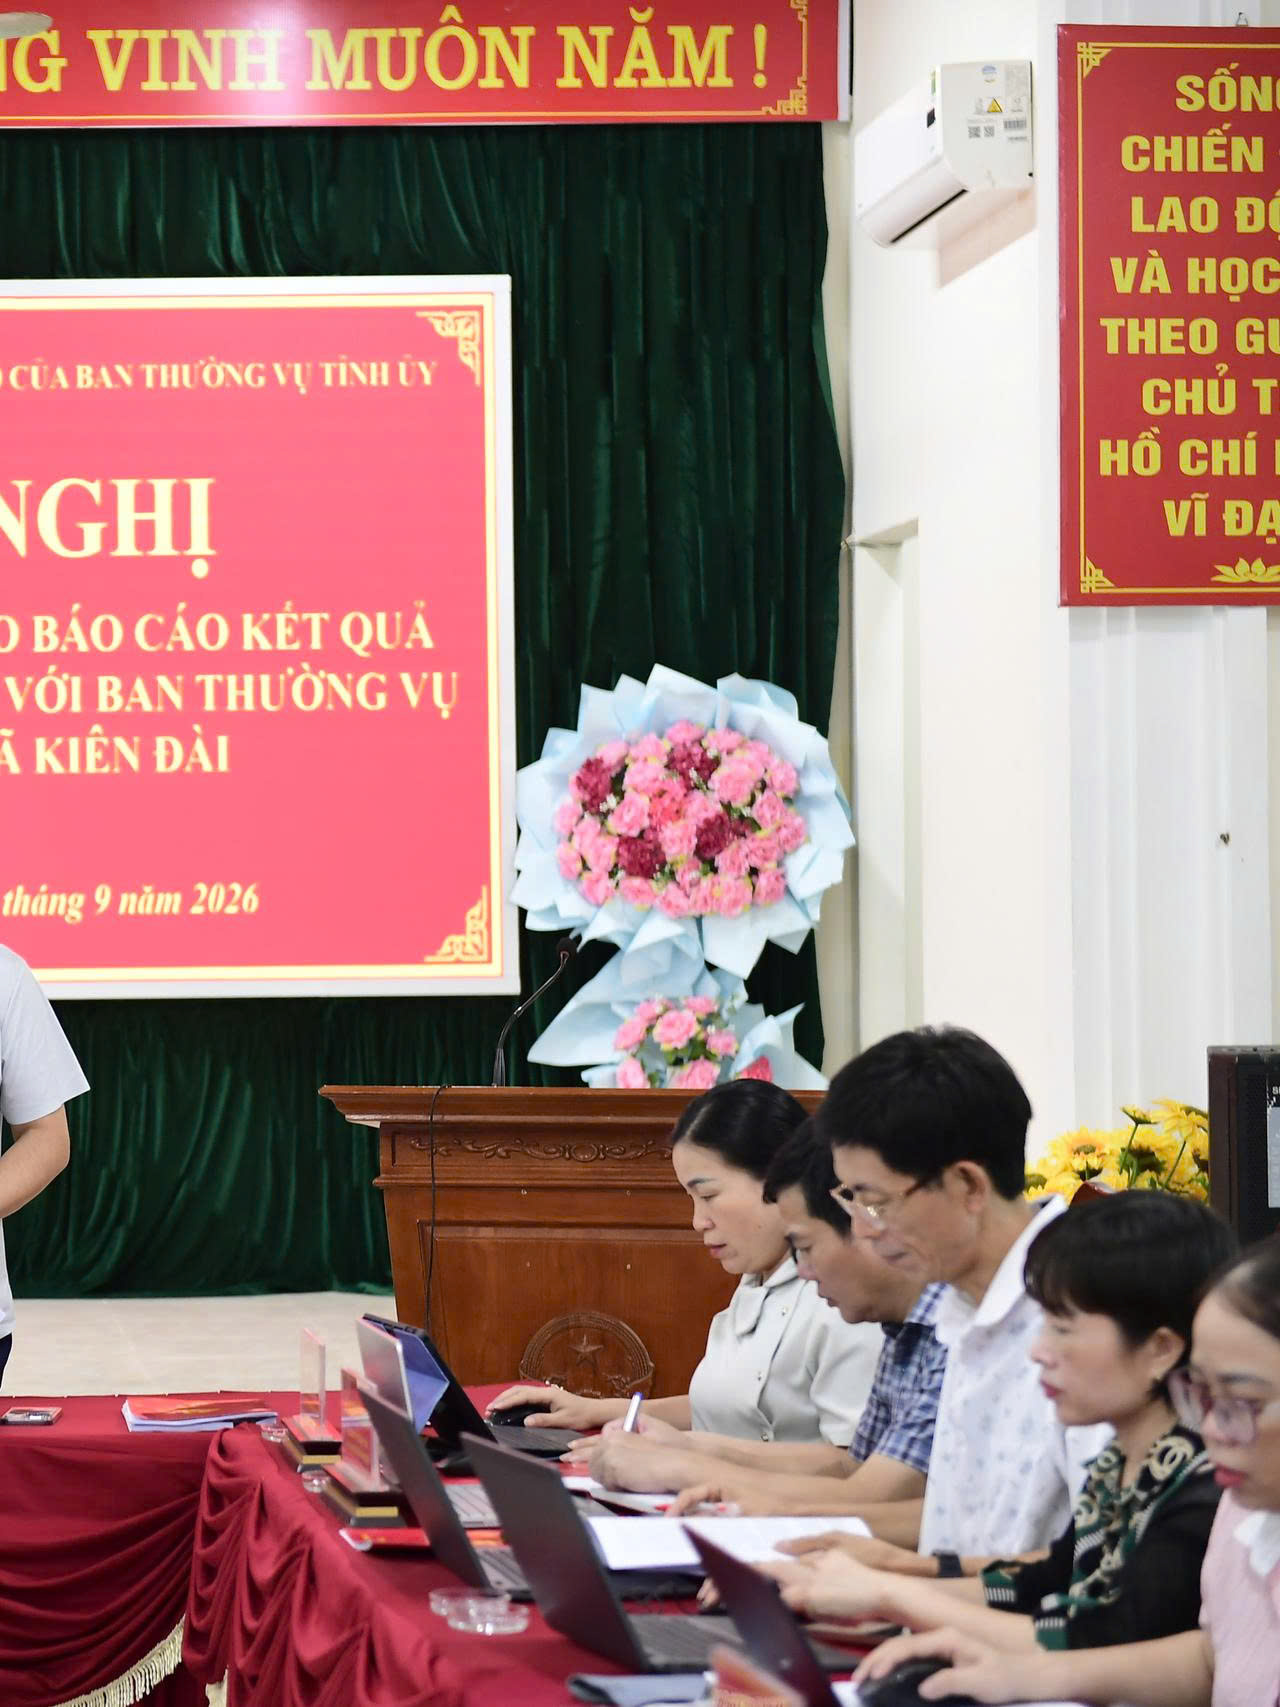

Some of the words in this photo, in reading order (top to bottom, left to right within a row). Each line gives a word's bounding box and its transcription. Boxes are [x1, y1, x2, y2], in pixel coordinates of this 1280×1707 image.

[86, 28, 286, 92] VINH
[306, 4, 536, 92] MUÔN
[556, 7, 733, 90] NĂM
[753, 24, 768, 88] !
[1121, 123, 1264, 173] CHIẾN
[1131, 196, 1219, 233] LAO
[1110, 249, 1172, 294] VÀ
[1187, 257, 1280, 302] HỌC
[1100, 318, 1218, 355] THEO
[8, 357, 70, 391] CỦA
[76, 363, 133, 390] BAN
[140, 355, 267, 389] THƯỜNG
[273, 361, 312, 395] VỤ
[319, 354, 391, 388] TỈNH
[398, 353, 438, 387] ỦY
[1142, 363, 1236, 416] CHỦ
[1099, 426, 1161, 476] HỒ
[1179, 431, 1257, 476] CHÍ
[1163, 492, 1209, 537] VĨ
[32, 602, 124, 653] BÁO
[133, 601, 230, 652] CÁO
[241, 600, 331, 651] KẾT
[339, 600, 435, 658] QUẢ
[4, 664, 83, 714] VỚI
[94, 674, 184, 713] BAN
[193, 662, 388, 711] THƯỜNG
[399, 671, 459, 720] VỤ
[34, 725, 140, 775] KIÊN
[152, 724, 231, 774] ĐÀI
[2, 885, 86, 925] tháng
[94, 883, 113, 915] 9
[118, 885, 182, 916] năm
[189, 882, 261, 915] 2026
